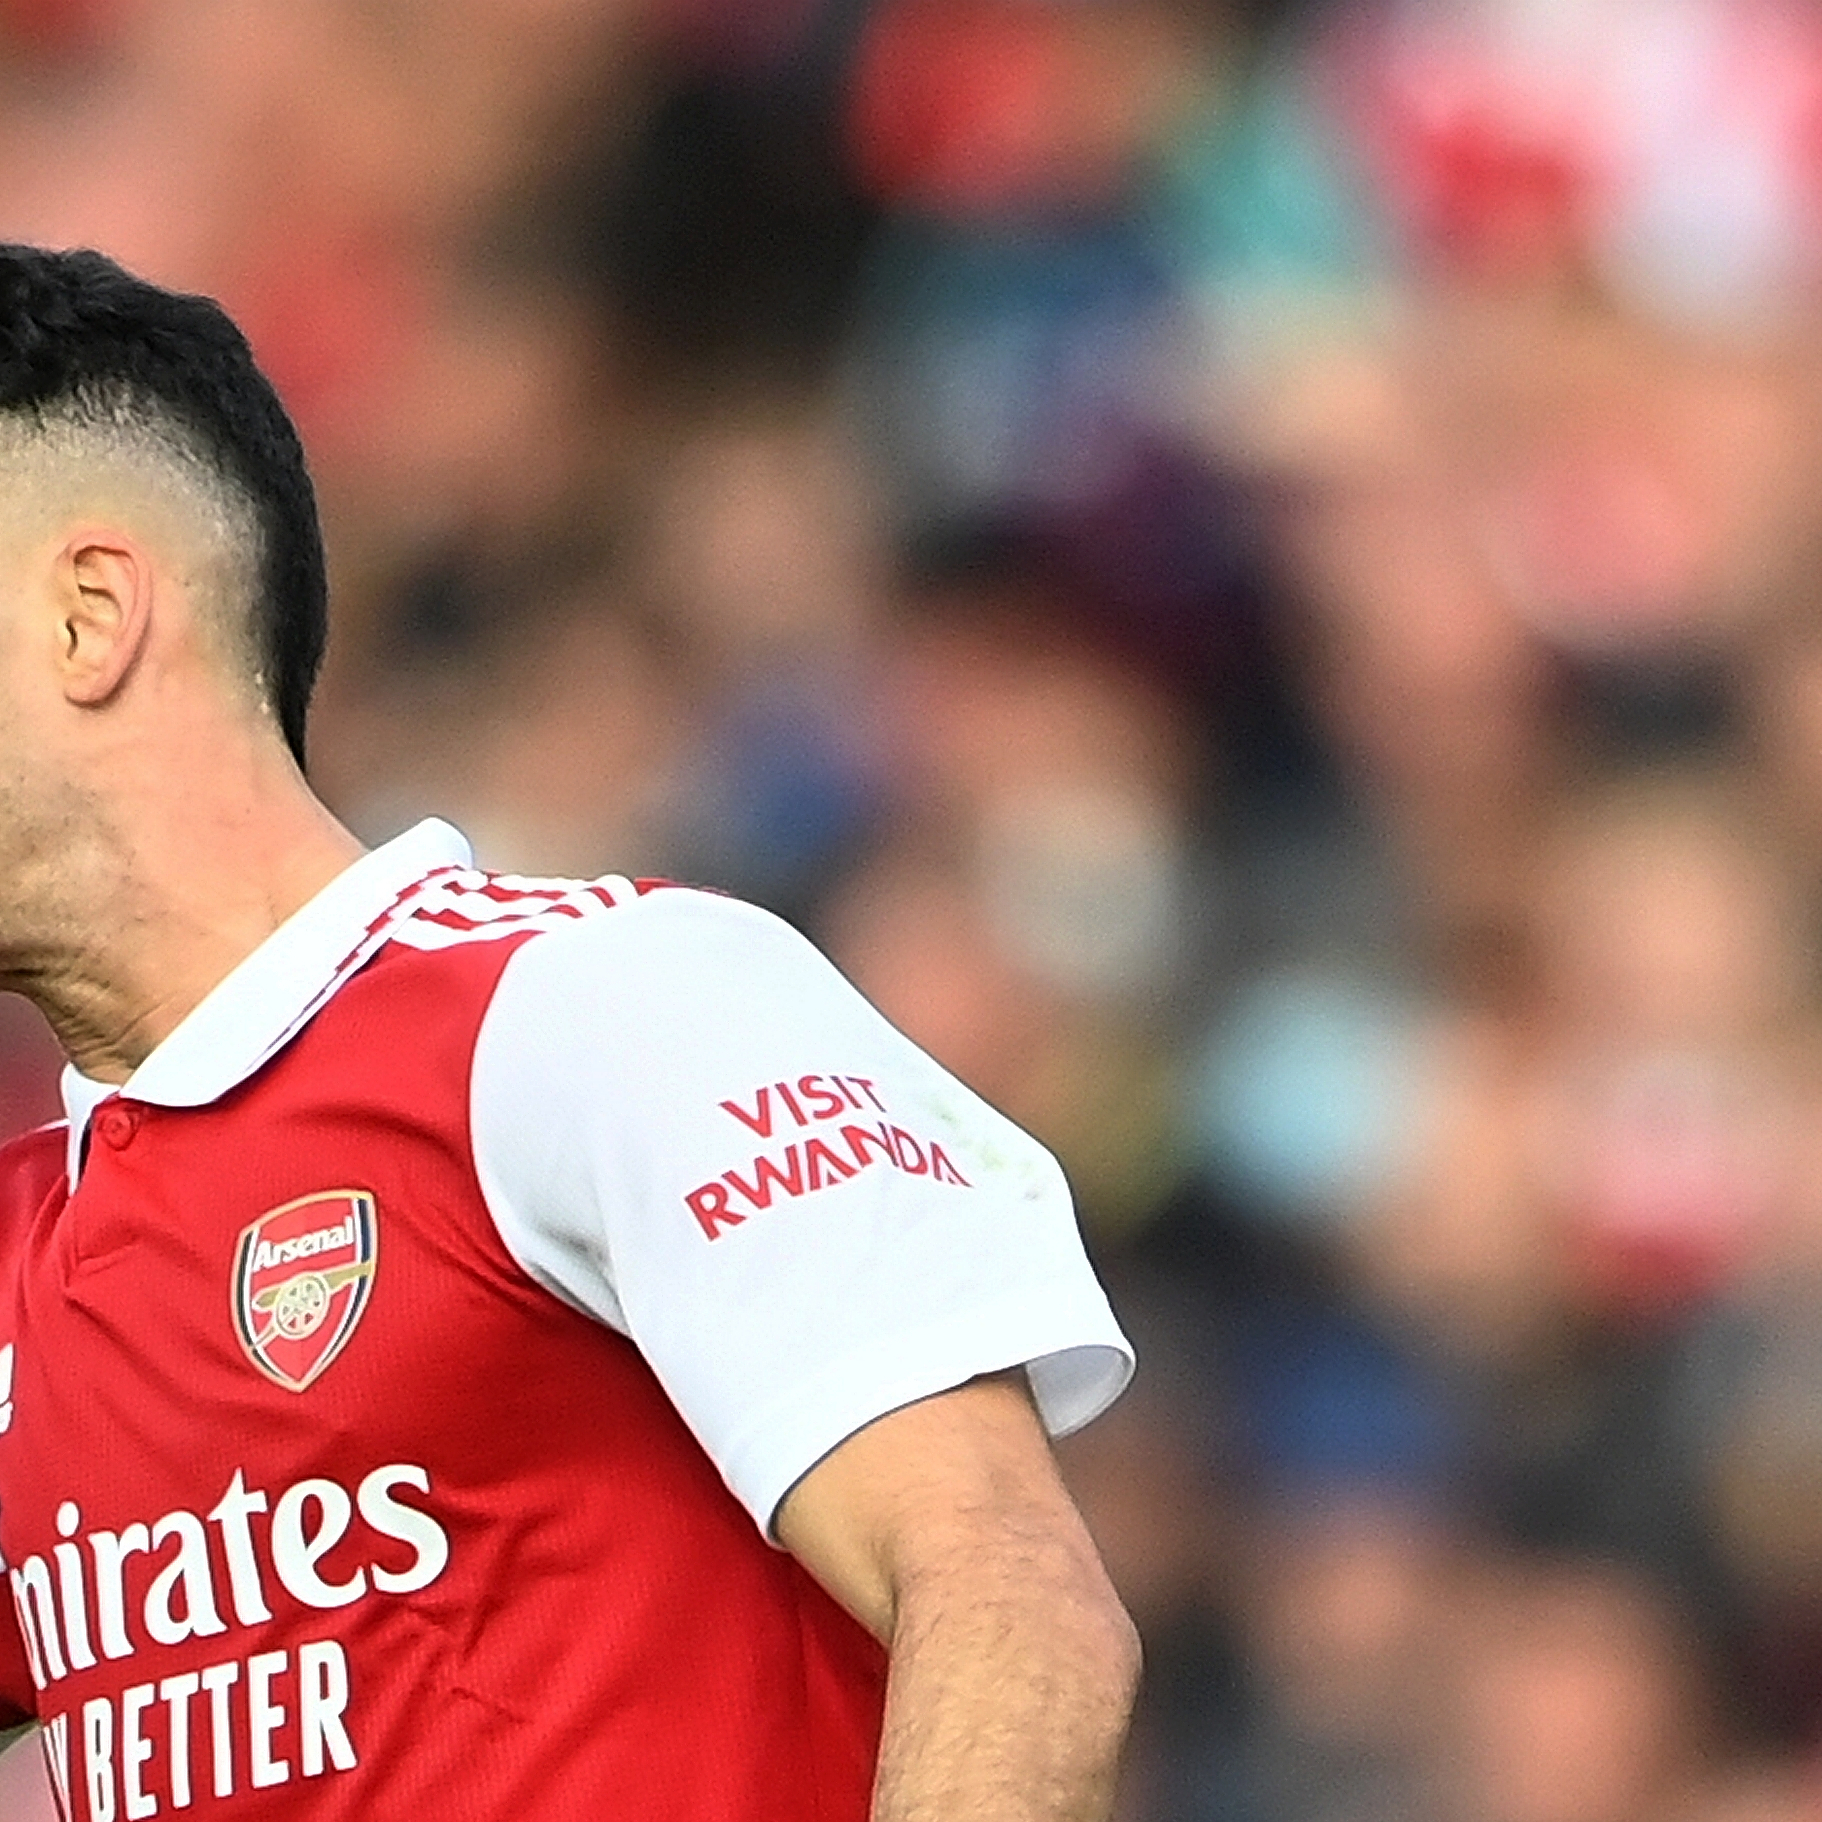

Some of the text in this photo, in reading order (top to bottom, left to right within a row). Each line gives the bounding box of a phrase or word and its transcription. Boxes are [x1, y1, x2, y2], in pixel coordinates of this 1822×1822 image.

[718, 1074, 887, 1138] VISIT
[684, 1120, 974, 1241] RWANDA
[253, 1215, 355, 1273] Arsenal
[10, 1463, 449, 1691] mirates
